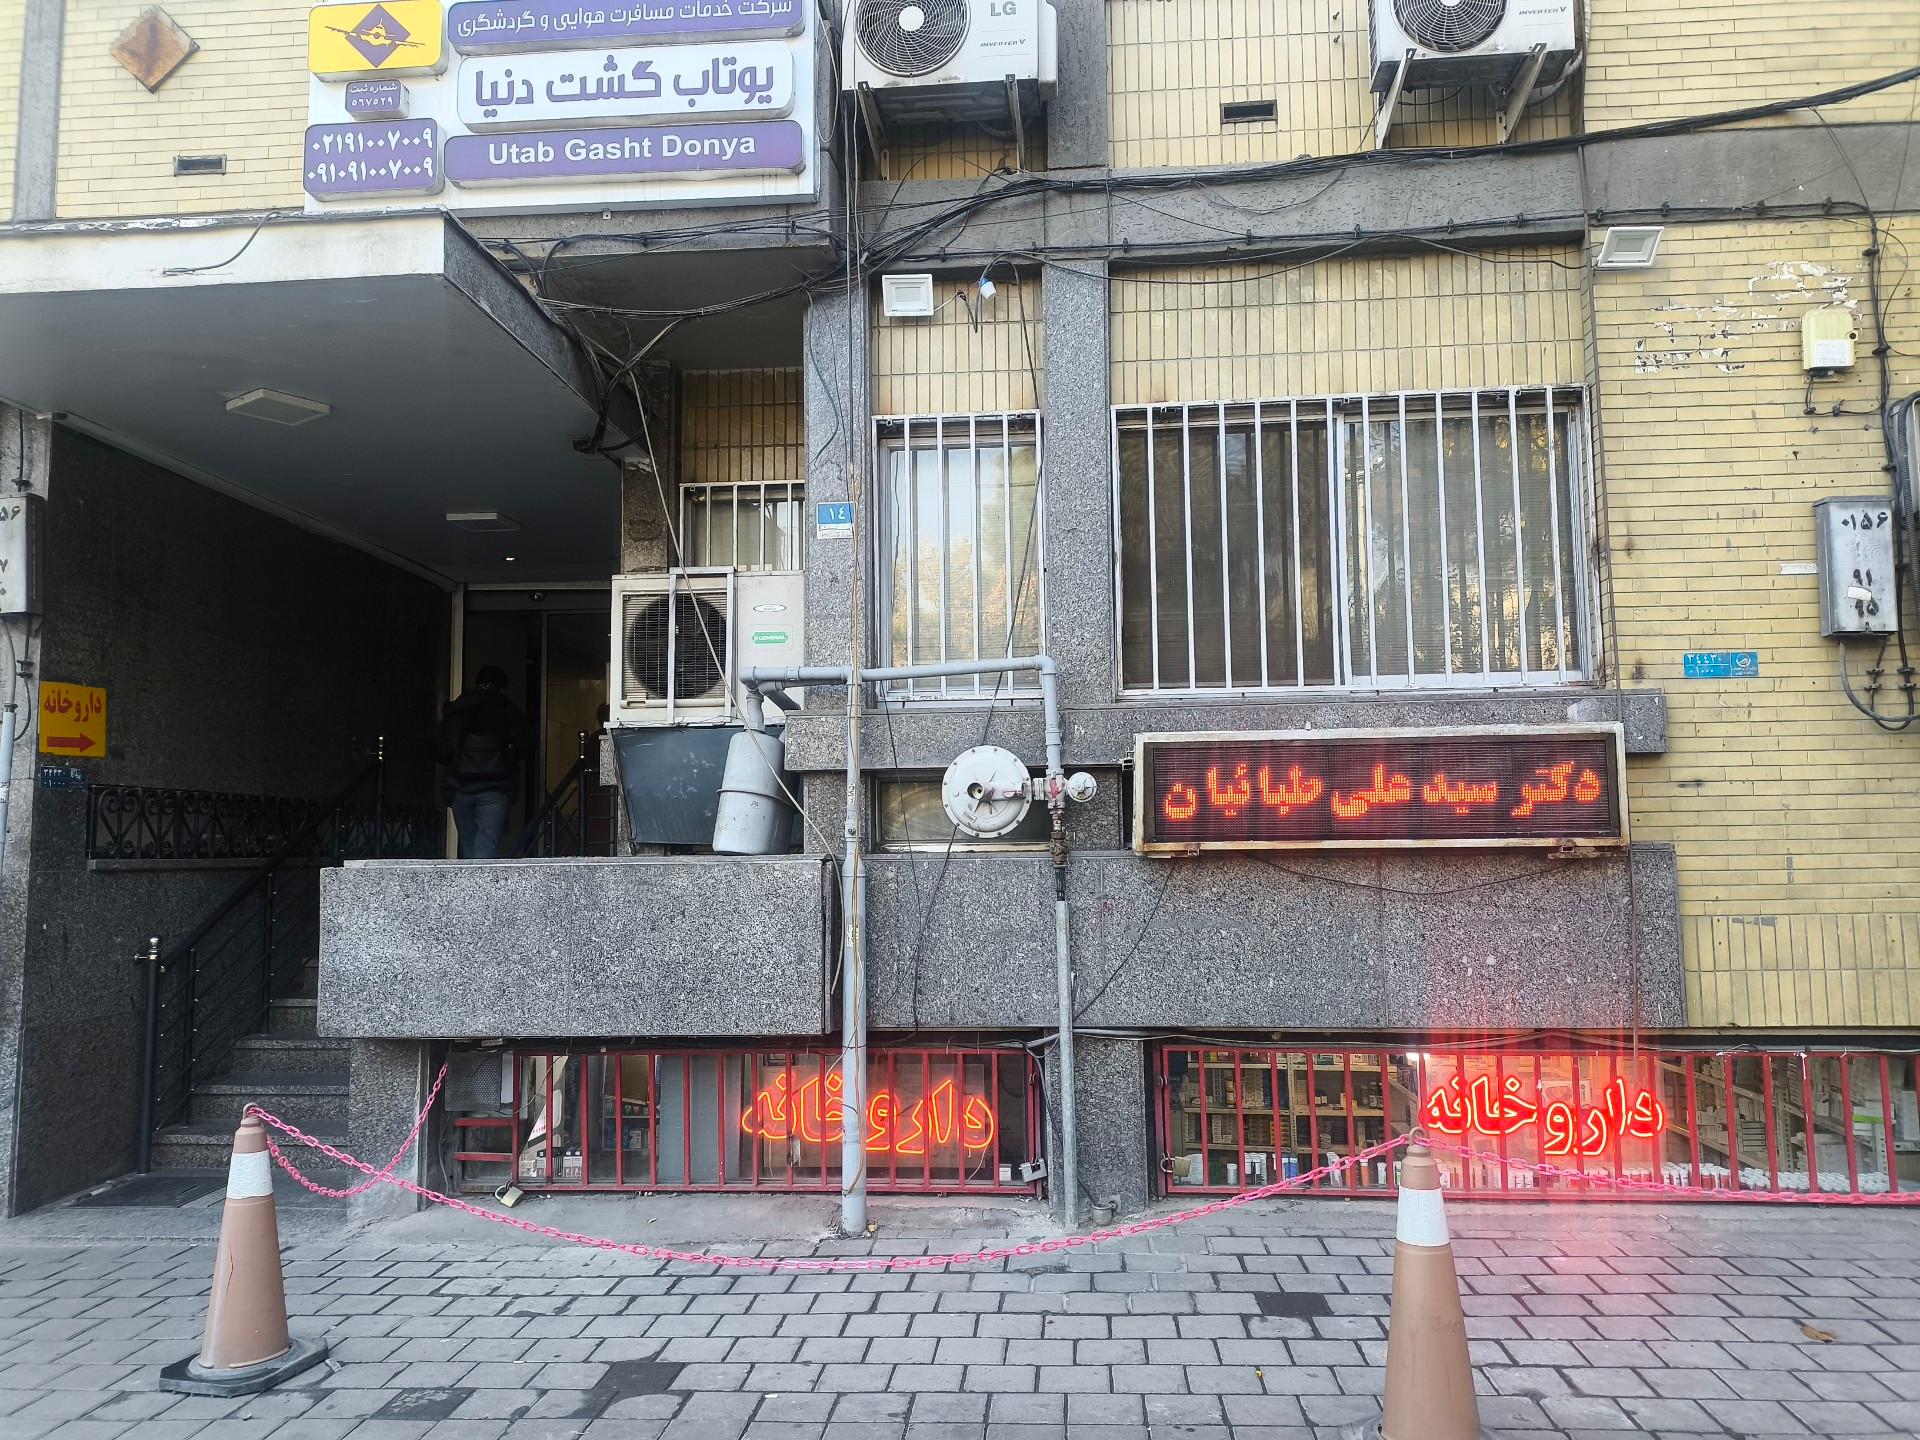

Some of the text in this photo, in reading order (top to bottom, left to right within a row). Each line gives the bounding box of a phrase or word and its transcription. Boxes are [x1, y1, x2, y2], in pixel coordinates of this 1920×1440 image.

[457, 9, 536, 38] گردشگری
[540, 14, 549, 31] و
[553, 8, 605, 31] هوایی
[610, 3, 674, 27] مسافرت
[679, 0, 733, 19] خدمات
[990, 1, 1017, 17] LG
[369, 83, 398, 94] شماره
[475, 54, 775, 118] یوتاب گشت دنیا
[312, 127, 434, 155] ۰۲۱۹۱۰۰۷۰۰۹
[488, 133, 756, 165] Utab Gasht Donya
[307, 156, 434, 184] ۰۹۱۰۹۱۰۰۷۰۰۹
[44, 688, 103, 722] داروخانه
[1331, 763, 1411, 817] علی
[1423, 773, 1498, 814] سید
[1511, 761, 1600, 818] دکتر
[741, 1072, 995, 1154] داروخانه
[1425, 1073, 1664, 1157] داروخانه
